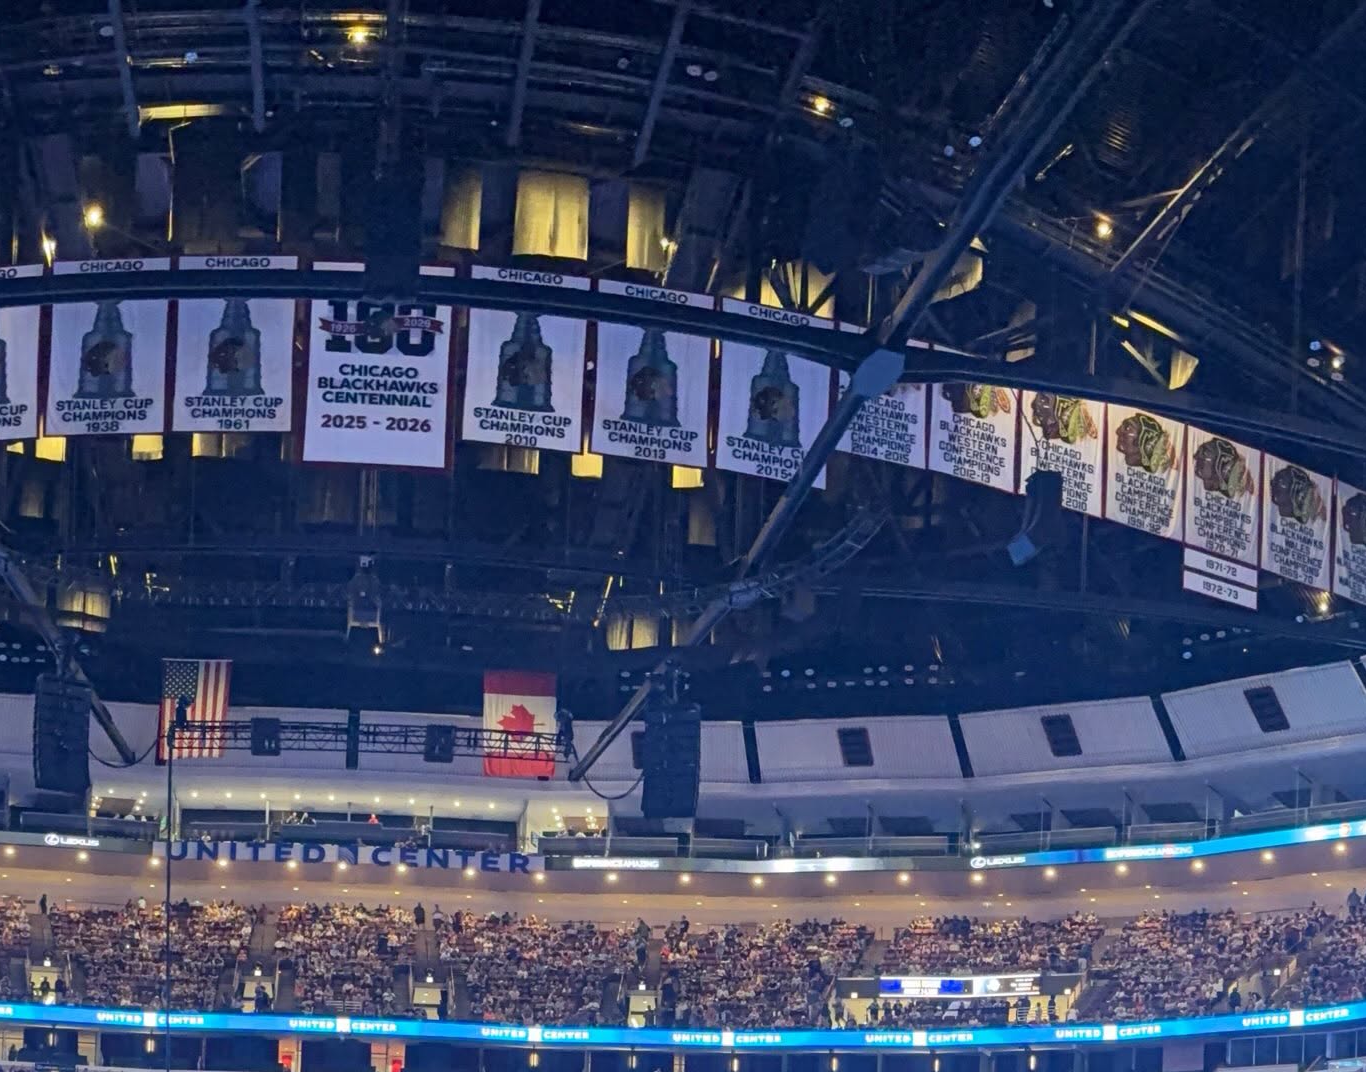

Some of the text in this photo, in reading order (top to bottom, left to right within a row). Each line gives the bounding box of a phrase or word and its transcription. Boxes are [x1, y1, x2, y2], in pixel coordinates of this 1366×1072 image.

[79, 260, 144, 273] CHICAGO
[205, 257, 271, 269] CHICAGO
[498, 268, 564, 286] CHICAGO
[625, 285, 689, 305] CHICAGO
[330, 318, 431, 333] 1926 2026
[748, 305, 810, 327] CHICAGO
[338, 363, 418, 379] CHICAGO
[317, 376, 438, 395] BLACKHAWKS
[55, 398, 153, 412] STANLEY CUP
[184, 396, 284, 408] STANLEY CUP
[322, 390, 432, 408] CENTENNIAL
[61, 409, 147, 422] CHAMPIONS
[190, 407, 276, 419] CHAMPIONS
[473, 407, 572, 428] STANLEY CUP
[85, 421, 120, 432] 1938
[217, 419, 250, 430] 1961
[320, 414, 367, 429] 2025
[385, 417, 431, 433] 2026
[479, 419, 565, 439] CHAMPIONS
[602, 419, 699, 442] STANLEY CUP
[952, 414, 995, 434] CHICAGO
[505, 434, 538, 447] 2010
[608, 432, 692, 453] CHAMPIONS
[851, 433, 912, 454] CHAMPIONS
[940, 421, 1007, 447] BLACKHAWKS
[634, 446, 666, 460] 2013
[726, 436, 786, 455] STANLEY
[939, 441, 1006, 467] CONFERENCE
[948, 434, 998, 455] WESTERN
[756, 464, 787, 479] 2015
[944, 453, 1001, 477] CHAMPIONS
[953, 465, 991, 484] 2012-13
[1115, 473, 1175, 500] BLACKHAWKS
[1127, 467, 1165, 487] CHICAGO
[1121, 485, 1169, 506] CAMPBELL
[1205, 491, 1242, 512] CHICAGO
[1115, 492, 1173, 519] CONFERENCE
[1194, 498, 1252, 525] BLACKHAWKS
[1119, 503, 1170, 528] CHAMPIONS
[1194, 516, 1251, 543] CONFERENCE
[1197, 528, 1247, 551] CHAMPIONS
[60, 837, 100, 848] LEXUS
[168, 840, 530, 874] UNITED CENTER
[987, 854, 1026, 867] LEXUS
[289, 1018, 398, 1033] UNITED CENTER
[1242, 1008, 1350, 1027] UNITED CENTER
[481, 1027, 590, 1041] UNITED CENTER
[673, 1032, 782, 1045] UNITED CENTER
[865, 1031, 974, 1045] UNITED CENTER
[1056, 1024, 1162, 1040] UNITED CENTER
